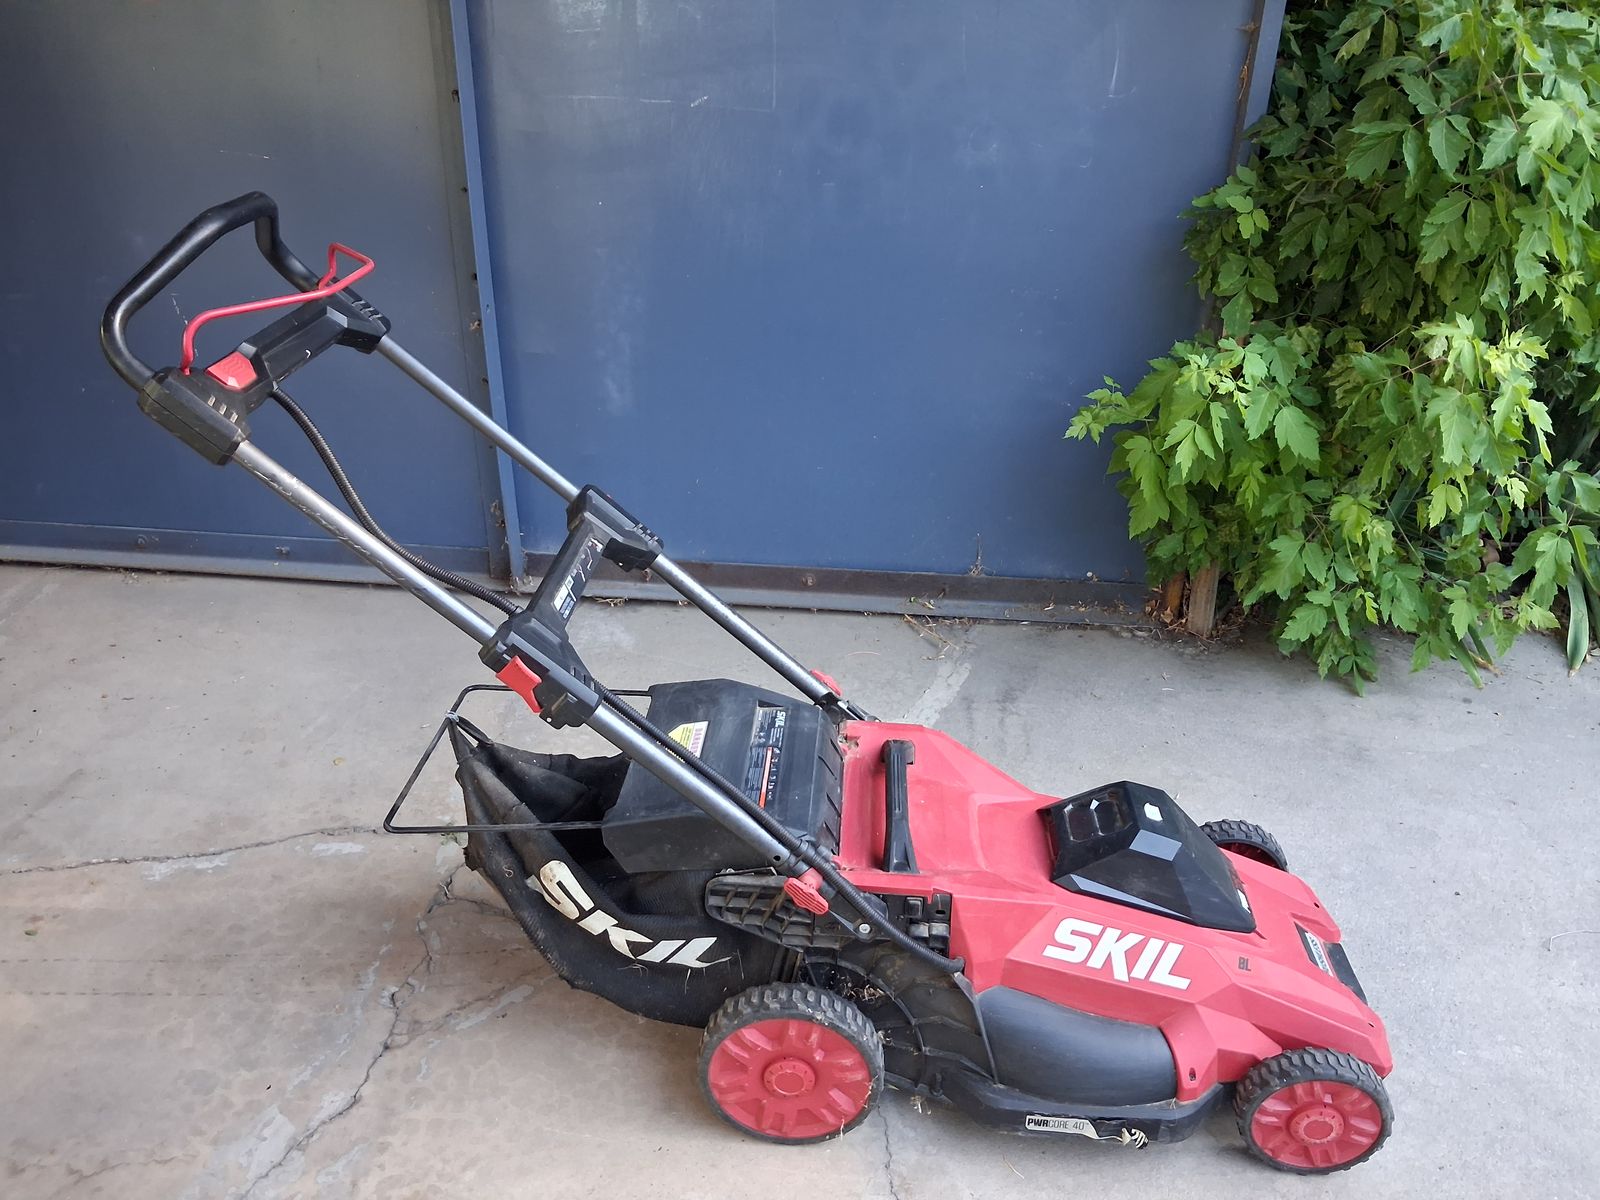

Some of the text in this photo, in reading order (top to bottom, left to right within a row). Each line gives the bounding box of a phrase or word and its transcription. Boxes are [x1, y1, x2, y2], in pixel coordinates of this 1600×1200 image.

[775, 710, 786, 727] SKIL
[525, 859, 731, 968] SKIL
[1041, 917, 1193, 991] SKIL
[1237, 956, 1252, 972] BL
[1027, 1117, 1085, 1131] PWRCORE 40
